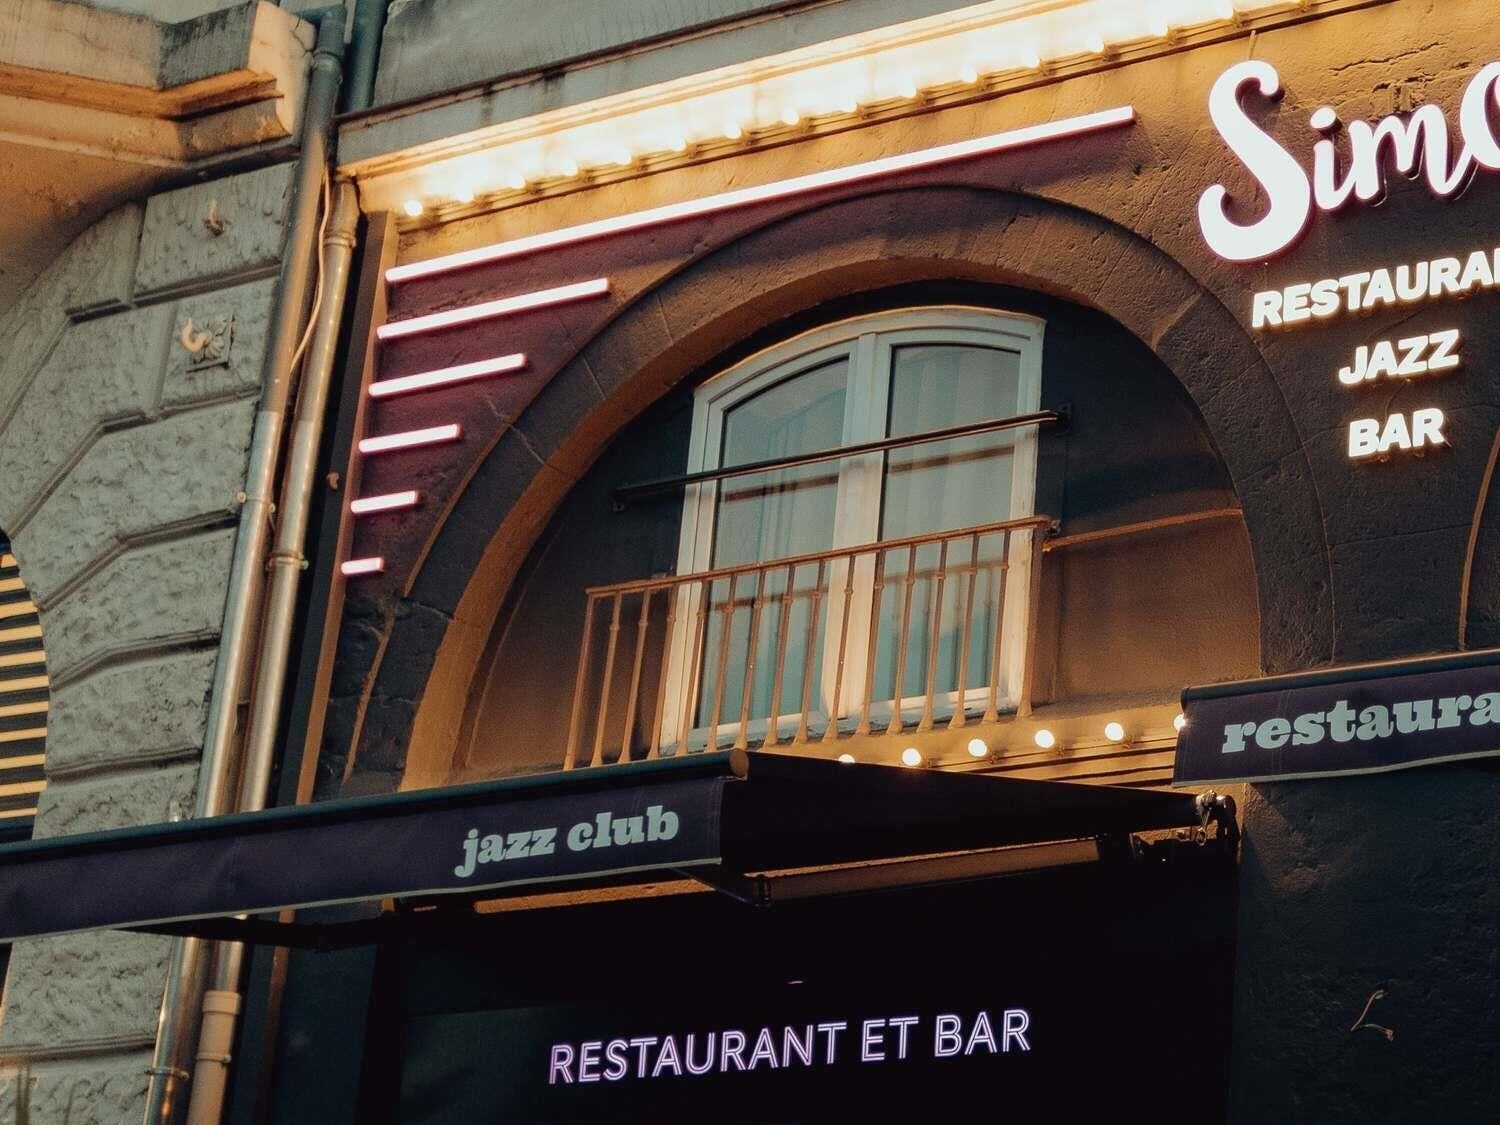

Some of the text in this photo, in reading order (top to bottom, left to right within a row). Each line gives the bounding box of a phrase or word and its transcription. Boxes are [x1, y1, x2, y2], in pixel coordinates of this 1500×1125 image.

[1339, 330, 1460, 385] JAZZ
[1348, 407, 1446, 458] BAR
[455, 805, 680, 878] jazz club
[549, 1008, 1031, 1085] RESTAURANT ET BAR
